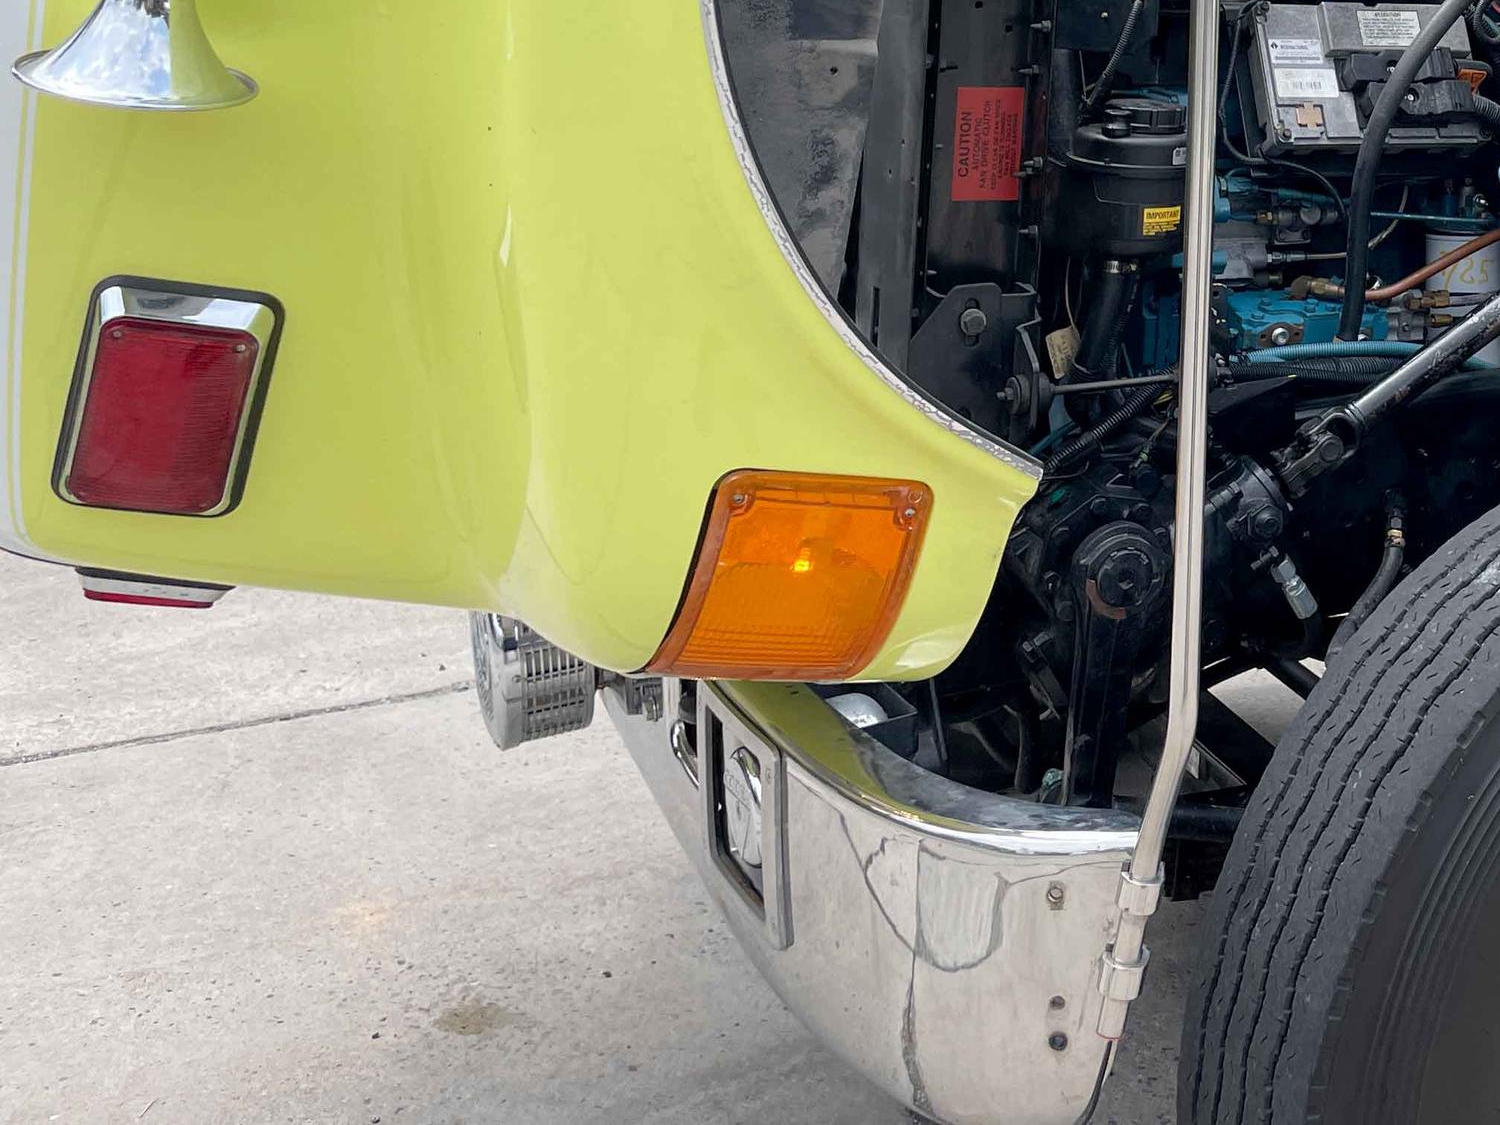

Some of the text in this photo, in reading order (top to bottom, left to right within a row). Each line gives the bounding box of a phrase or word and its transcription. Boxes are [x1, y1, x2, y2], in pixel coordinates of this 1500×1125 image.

[982, 100, 992, 137] CLUTCH
[957, 111, 972, 177] CAUTION
[972, 117, 982, 171] AUTOMATIC
[980, 140, 990, 167] DRIVE
[1146, 210, 1179, 219] IMPORTANT
